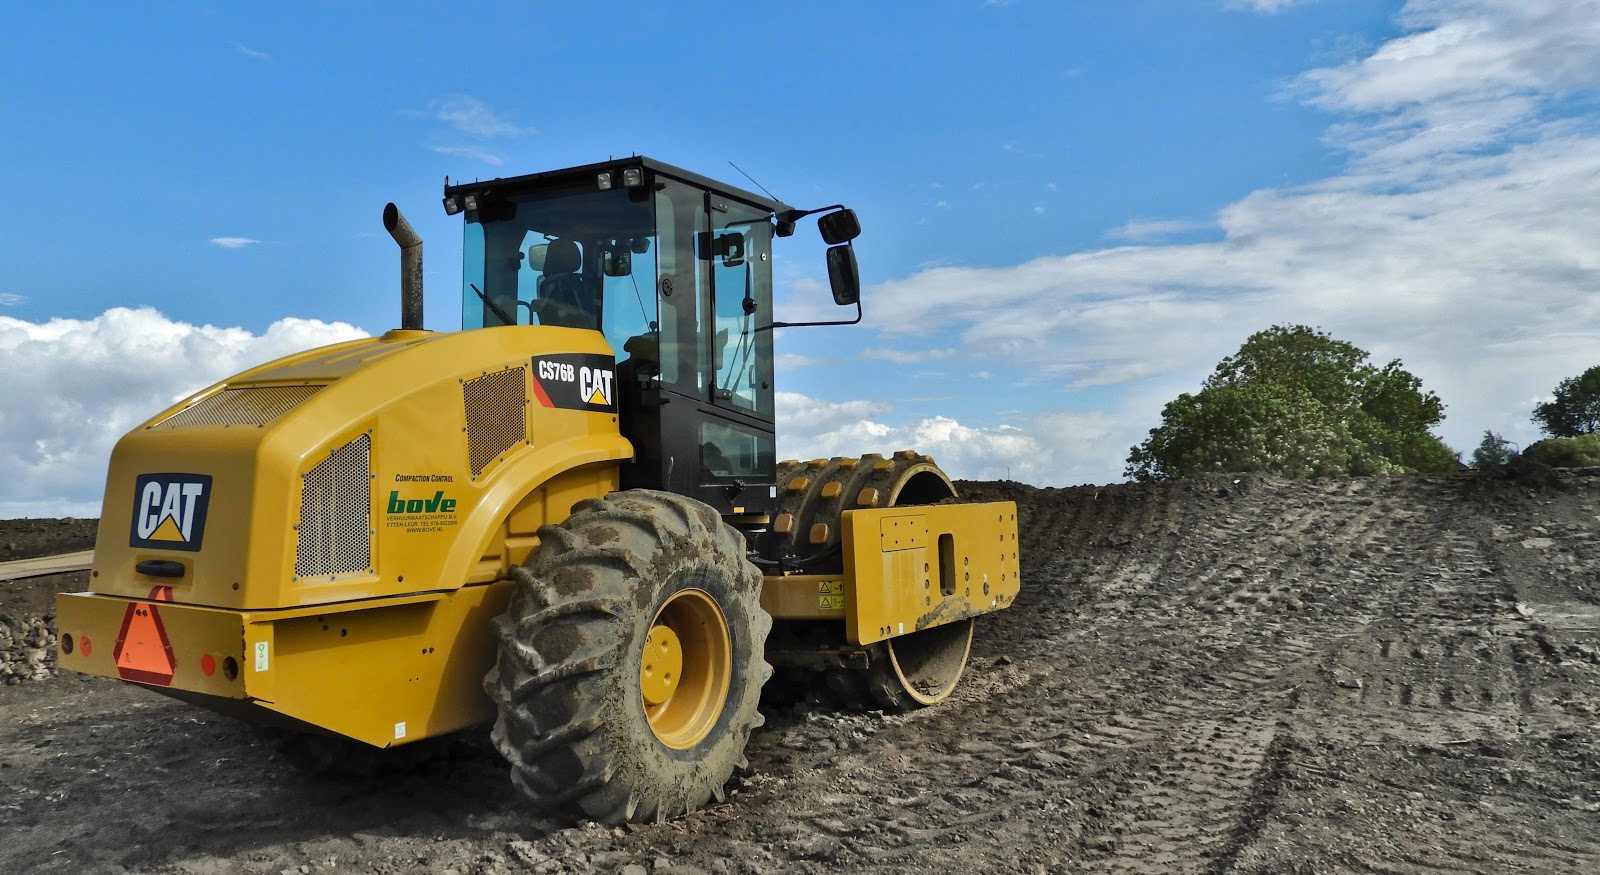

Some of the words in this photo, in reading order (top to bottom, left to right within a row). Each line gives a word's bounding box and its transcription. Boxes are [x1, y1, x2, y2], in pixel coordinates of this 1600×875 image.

[539, 360, 575, 383] CS76B
[580, 366, 613, 406] CAT
[137, 481, 203, 542] CAT
[387, 490, 457, 514] bove
